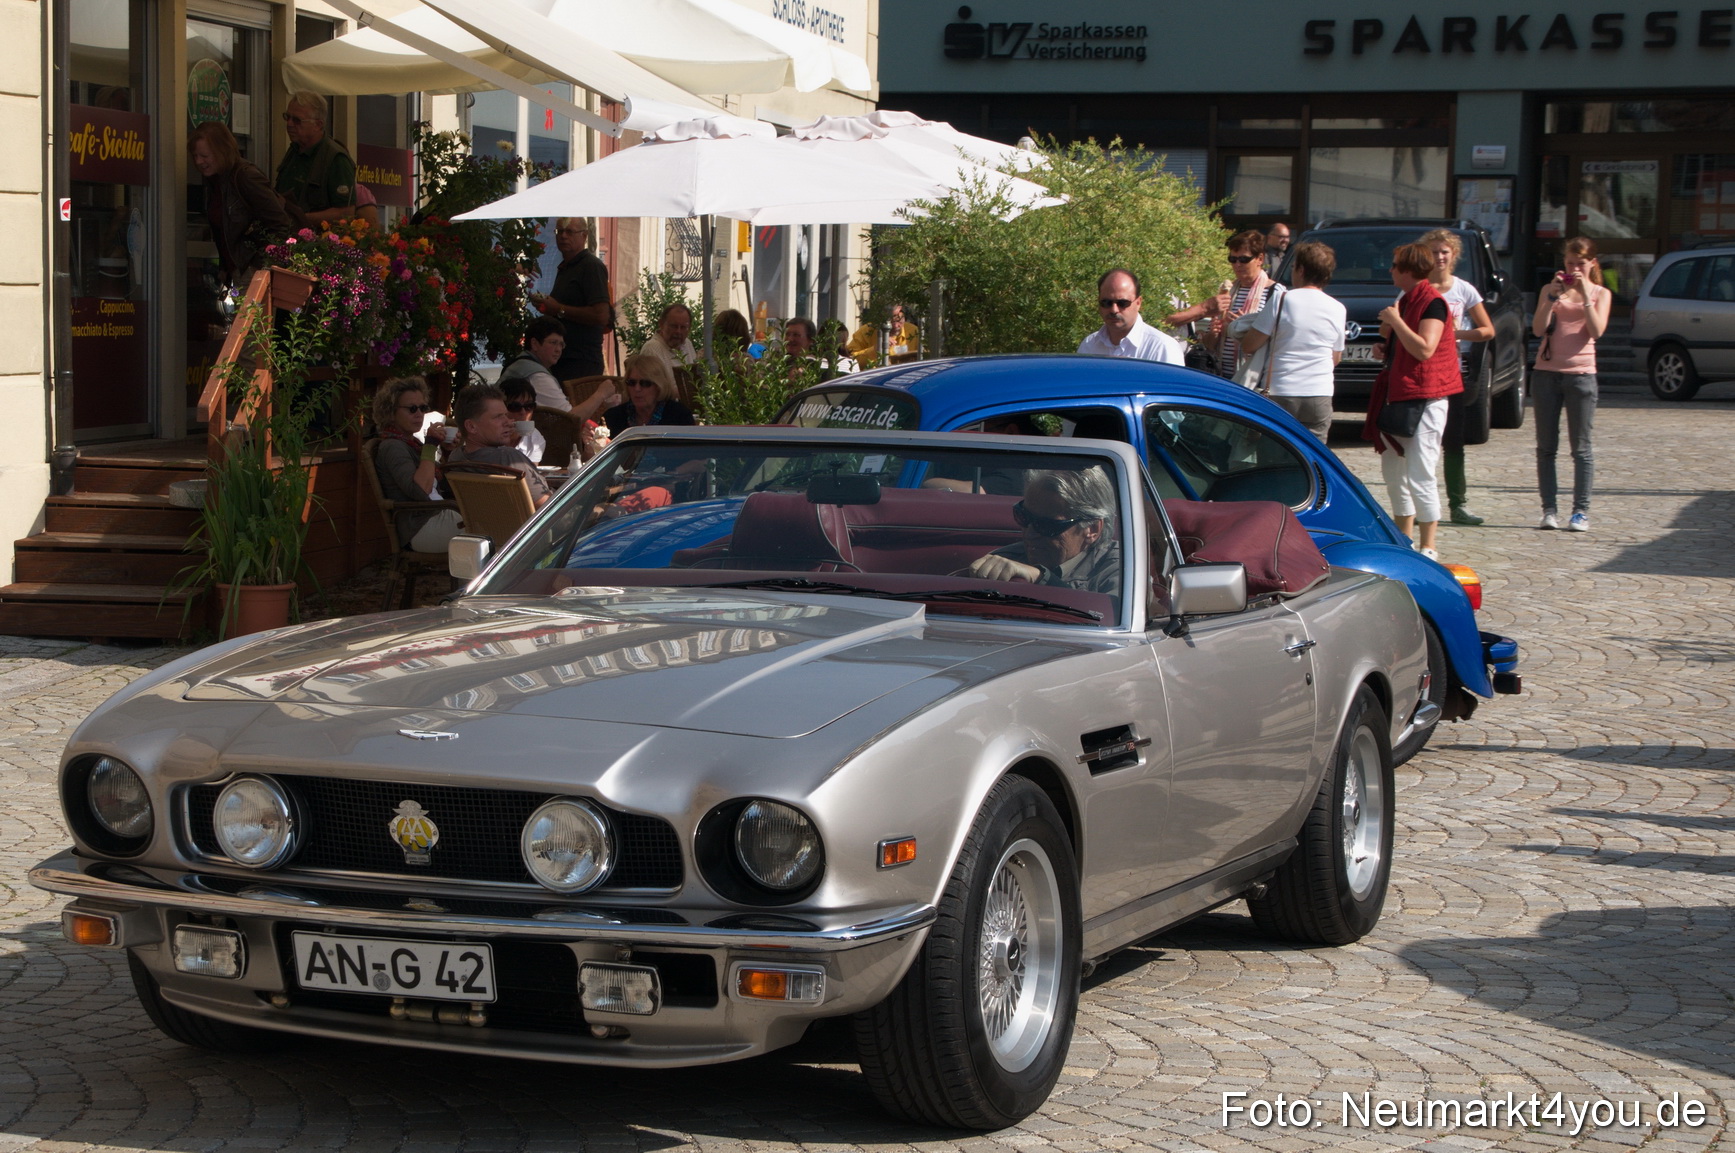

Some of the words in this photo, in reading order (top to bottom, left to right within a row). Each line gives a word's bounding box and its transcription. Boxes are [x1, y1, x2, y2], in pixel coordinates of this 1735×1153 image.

[773, 0, 805, 29] SCHLOSS
[810, 5, 844, 43] APOTHEKE
[1303, 9, 1733, 55] SPARKASSE
[1037, 22, 1147, 43] Sparkassen
[1026, 43, 1147, 62] Versicherung
[356, 165, 375, 183] Kaffee
[375, 167, 380, 184] &
[381, 168, 402, 186] Kuchen
[103, 323, 108, 336] &
[108, 323, 134, 340] Espresso
[1357, 347, 1376, 359] 17
[796, 402, 899, 428] www.ascari.de
[305, 941, 421, 989] AN-G
[435, 950, 487, 994] 42
